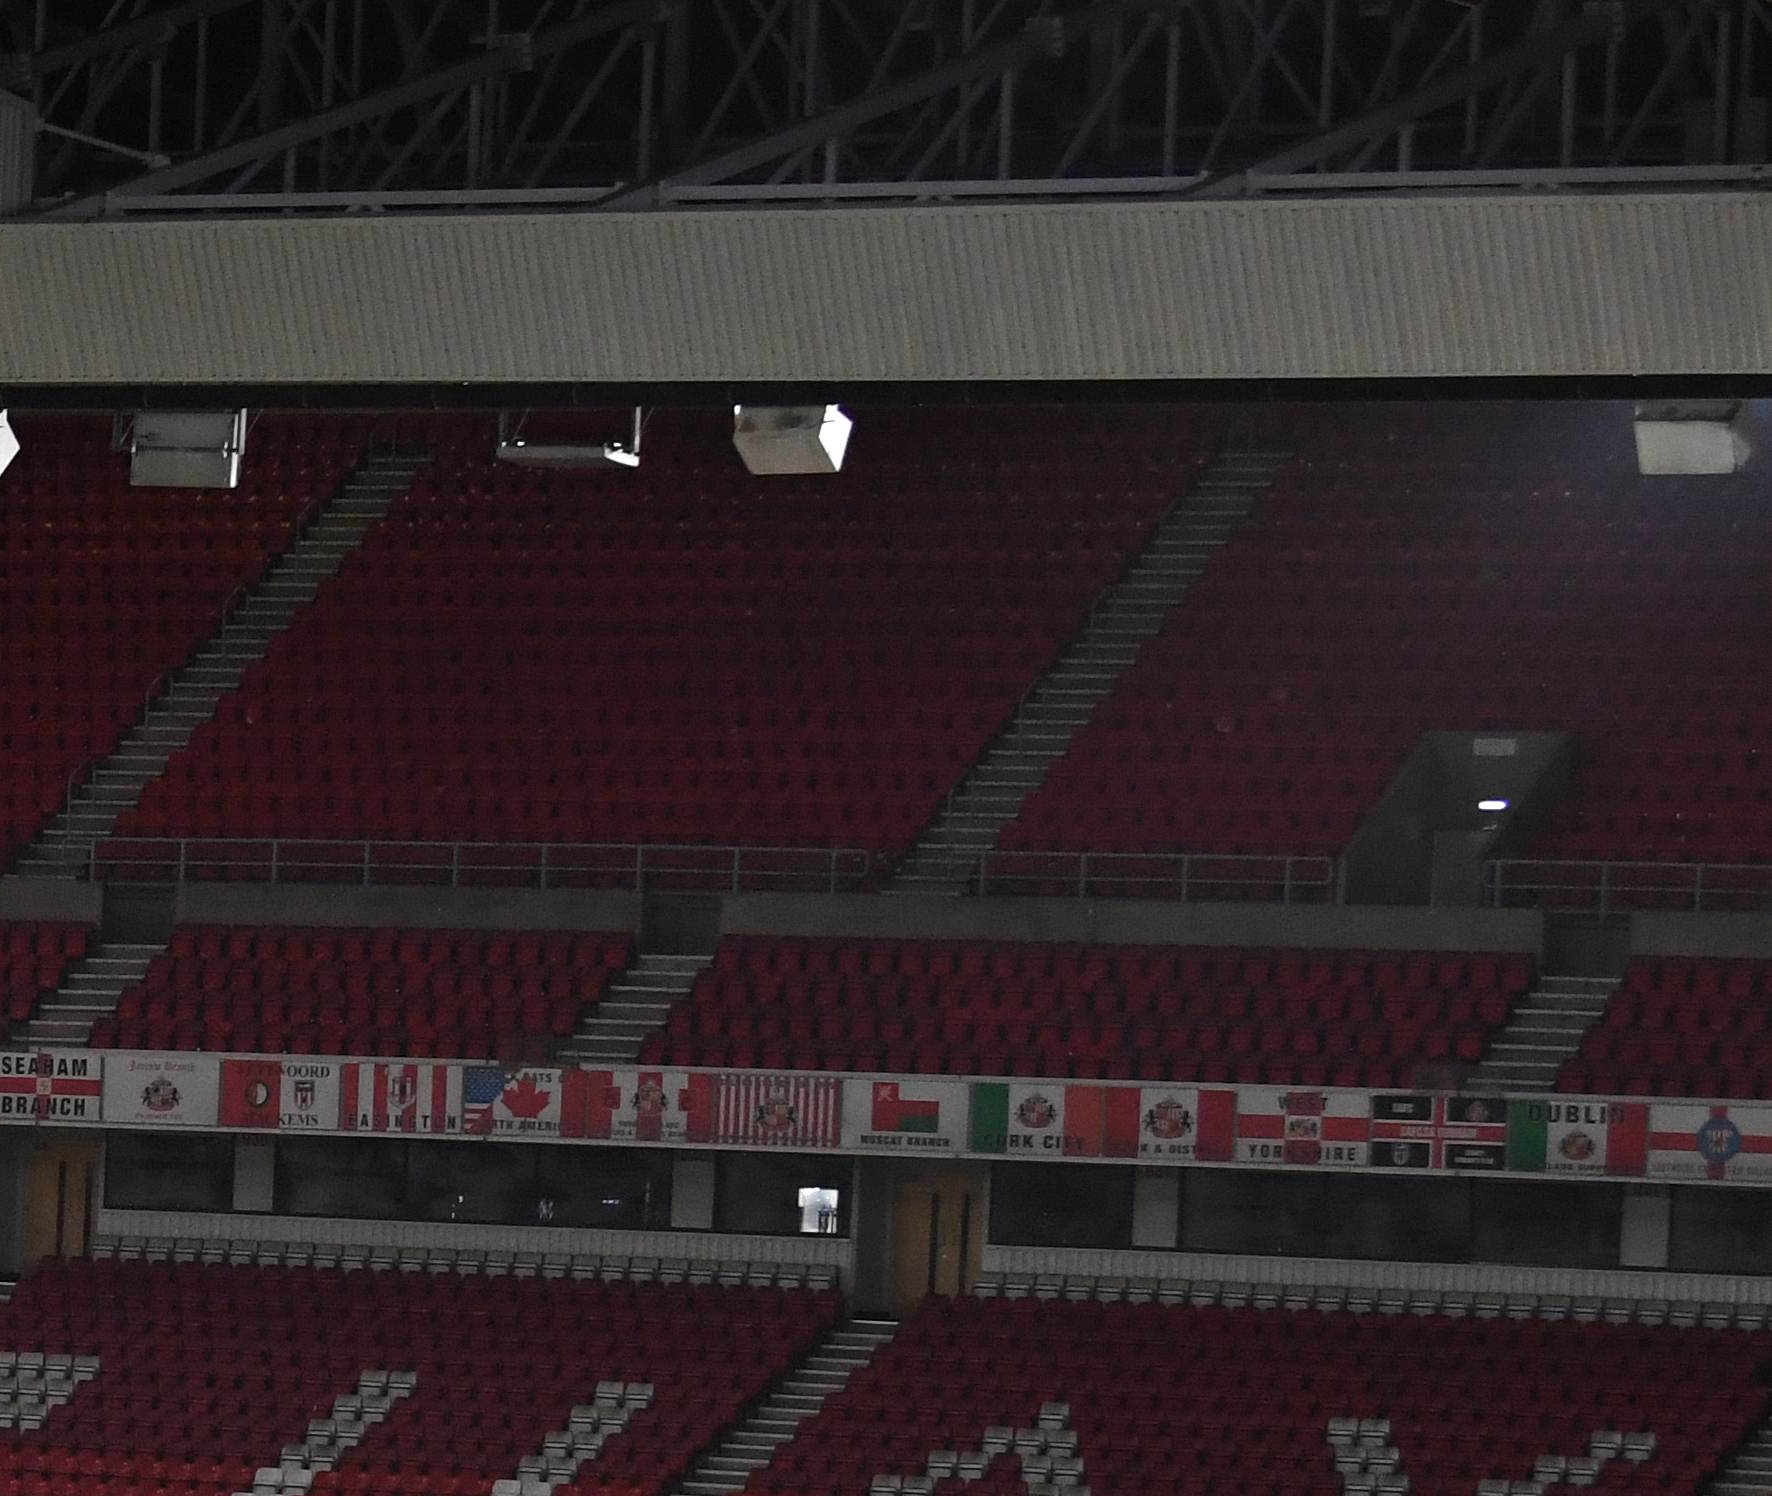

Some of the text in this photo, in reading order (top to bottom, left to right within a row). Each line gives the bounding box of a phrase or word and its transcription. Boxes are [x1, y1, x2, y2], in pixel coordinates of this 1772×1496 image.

[1, 1055, 88, 1076] SEAHAM
[1, 1096, 87, 1116] BRANCH
[1528, 1103, 1625, 1125] DUBLIN
[860, 1135, 950, 1147] MUSCAT BRANCH
[1249, 1144, 1356, 1161] YORHIRE
